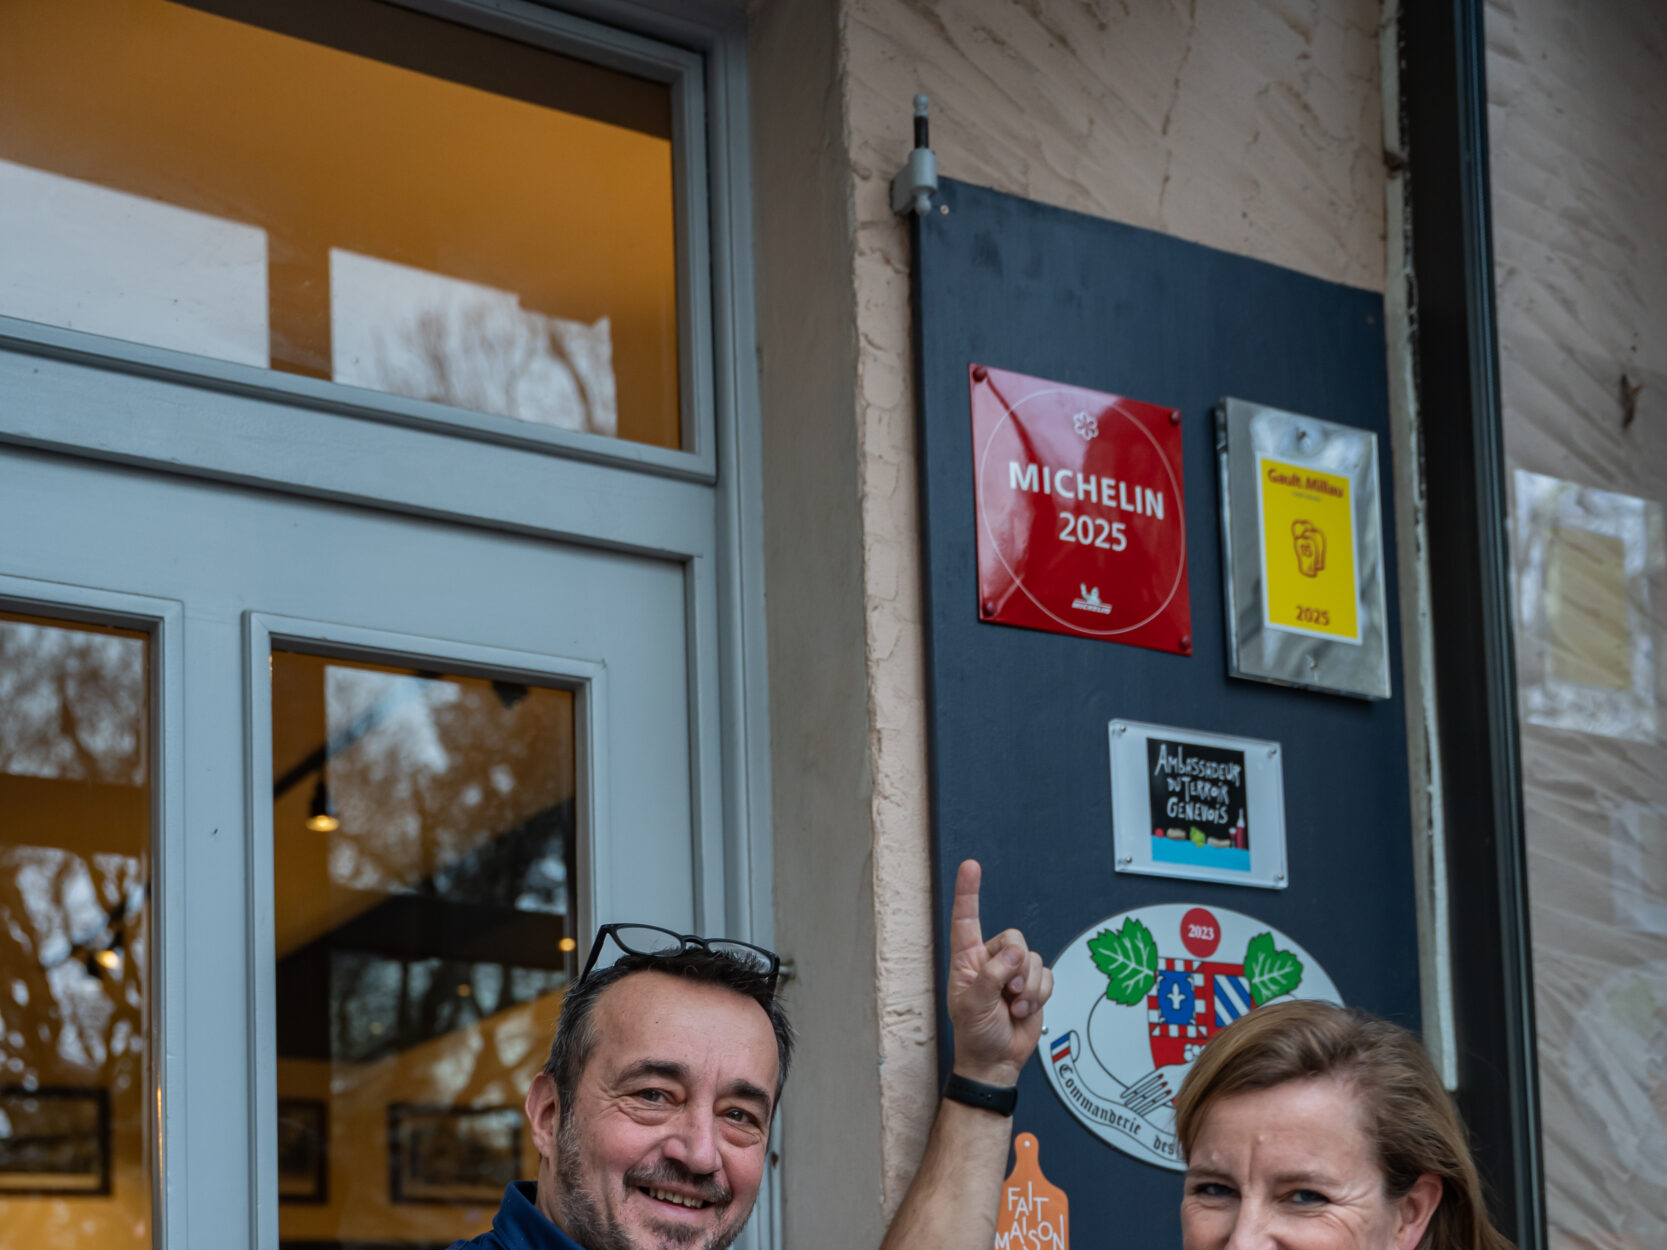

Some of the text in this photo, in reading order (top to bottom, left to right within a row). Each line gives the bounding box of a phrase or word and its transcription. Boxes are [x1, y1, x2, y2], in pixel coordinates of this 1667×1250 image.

[1009, 461, 1164, 520] MICHELIN
[1059, 511, 1127, 552] 2025
[1296, 605, 1330, 626] 2025
[1166, 777, 1181, 792] DU
[1187, 924, 1215, 941] 2023
[1058, 1063, 1174, 1155] Commanderie des
[1008, 1180, 1049, 1222] FAIT
